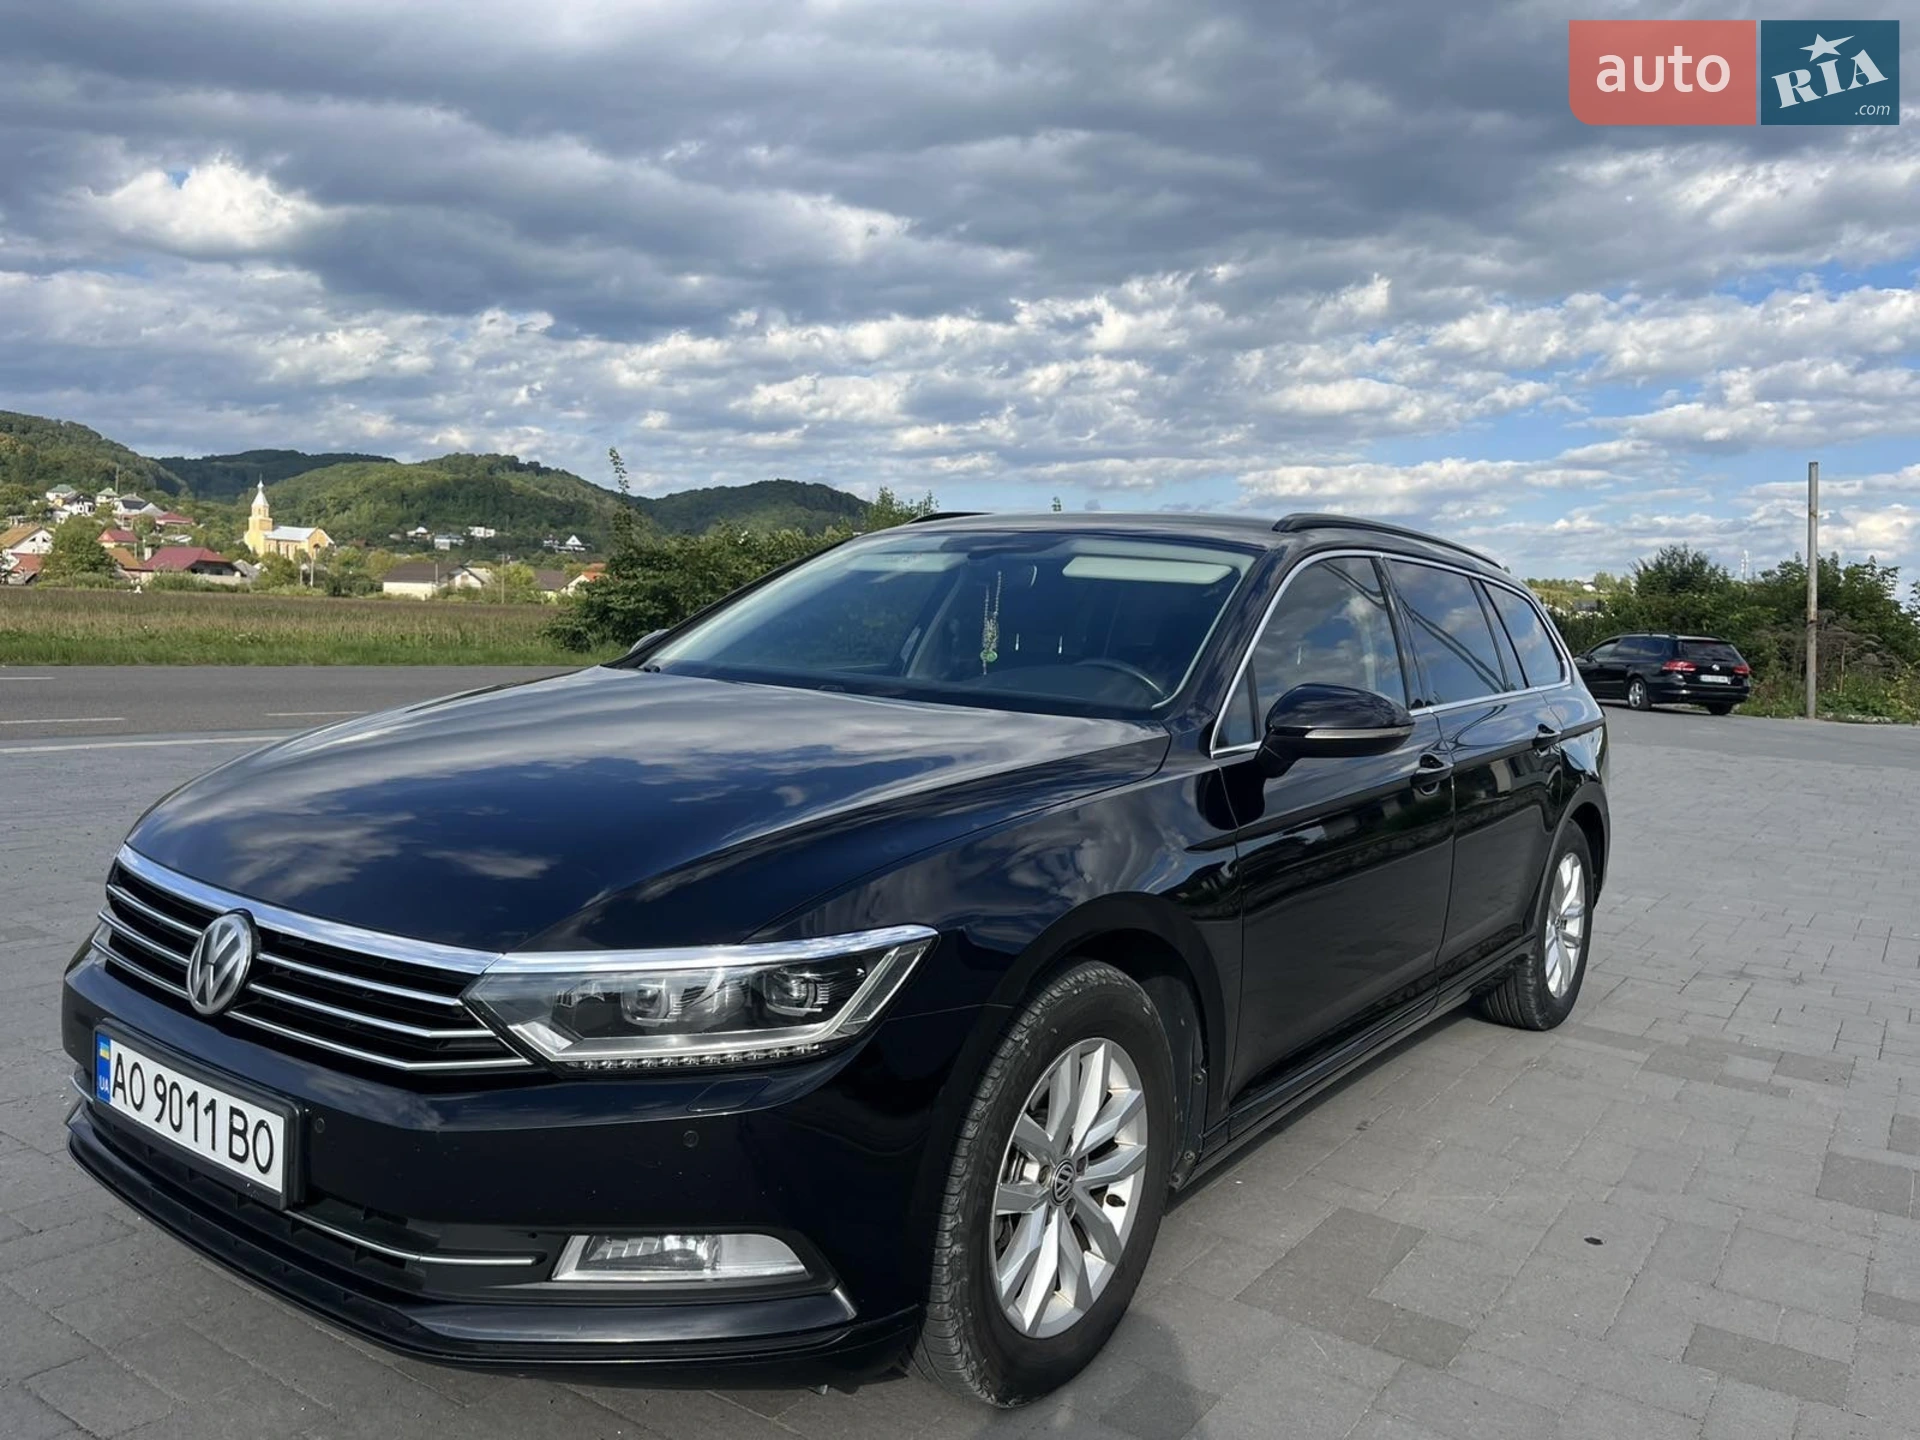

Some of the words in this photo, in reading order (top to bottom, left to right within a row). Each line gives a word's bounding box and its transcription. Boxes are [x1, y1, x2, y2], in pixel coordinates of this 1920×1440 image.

[98, 1074, 110, 1095] UA
[112, 1052, 146, 1112] AO
[154, 1073, 217, 1152] 9011
[228, 1105, 275, 1175] BO
